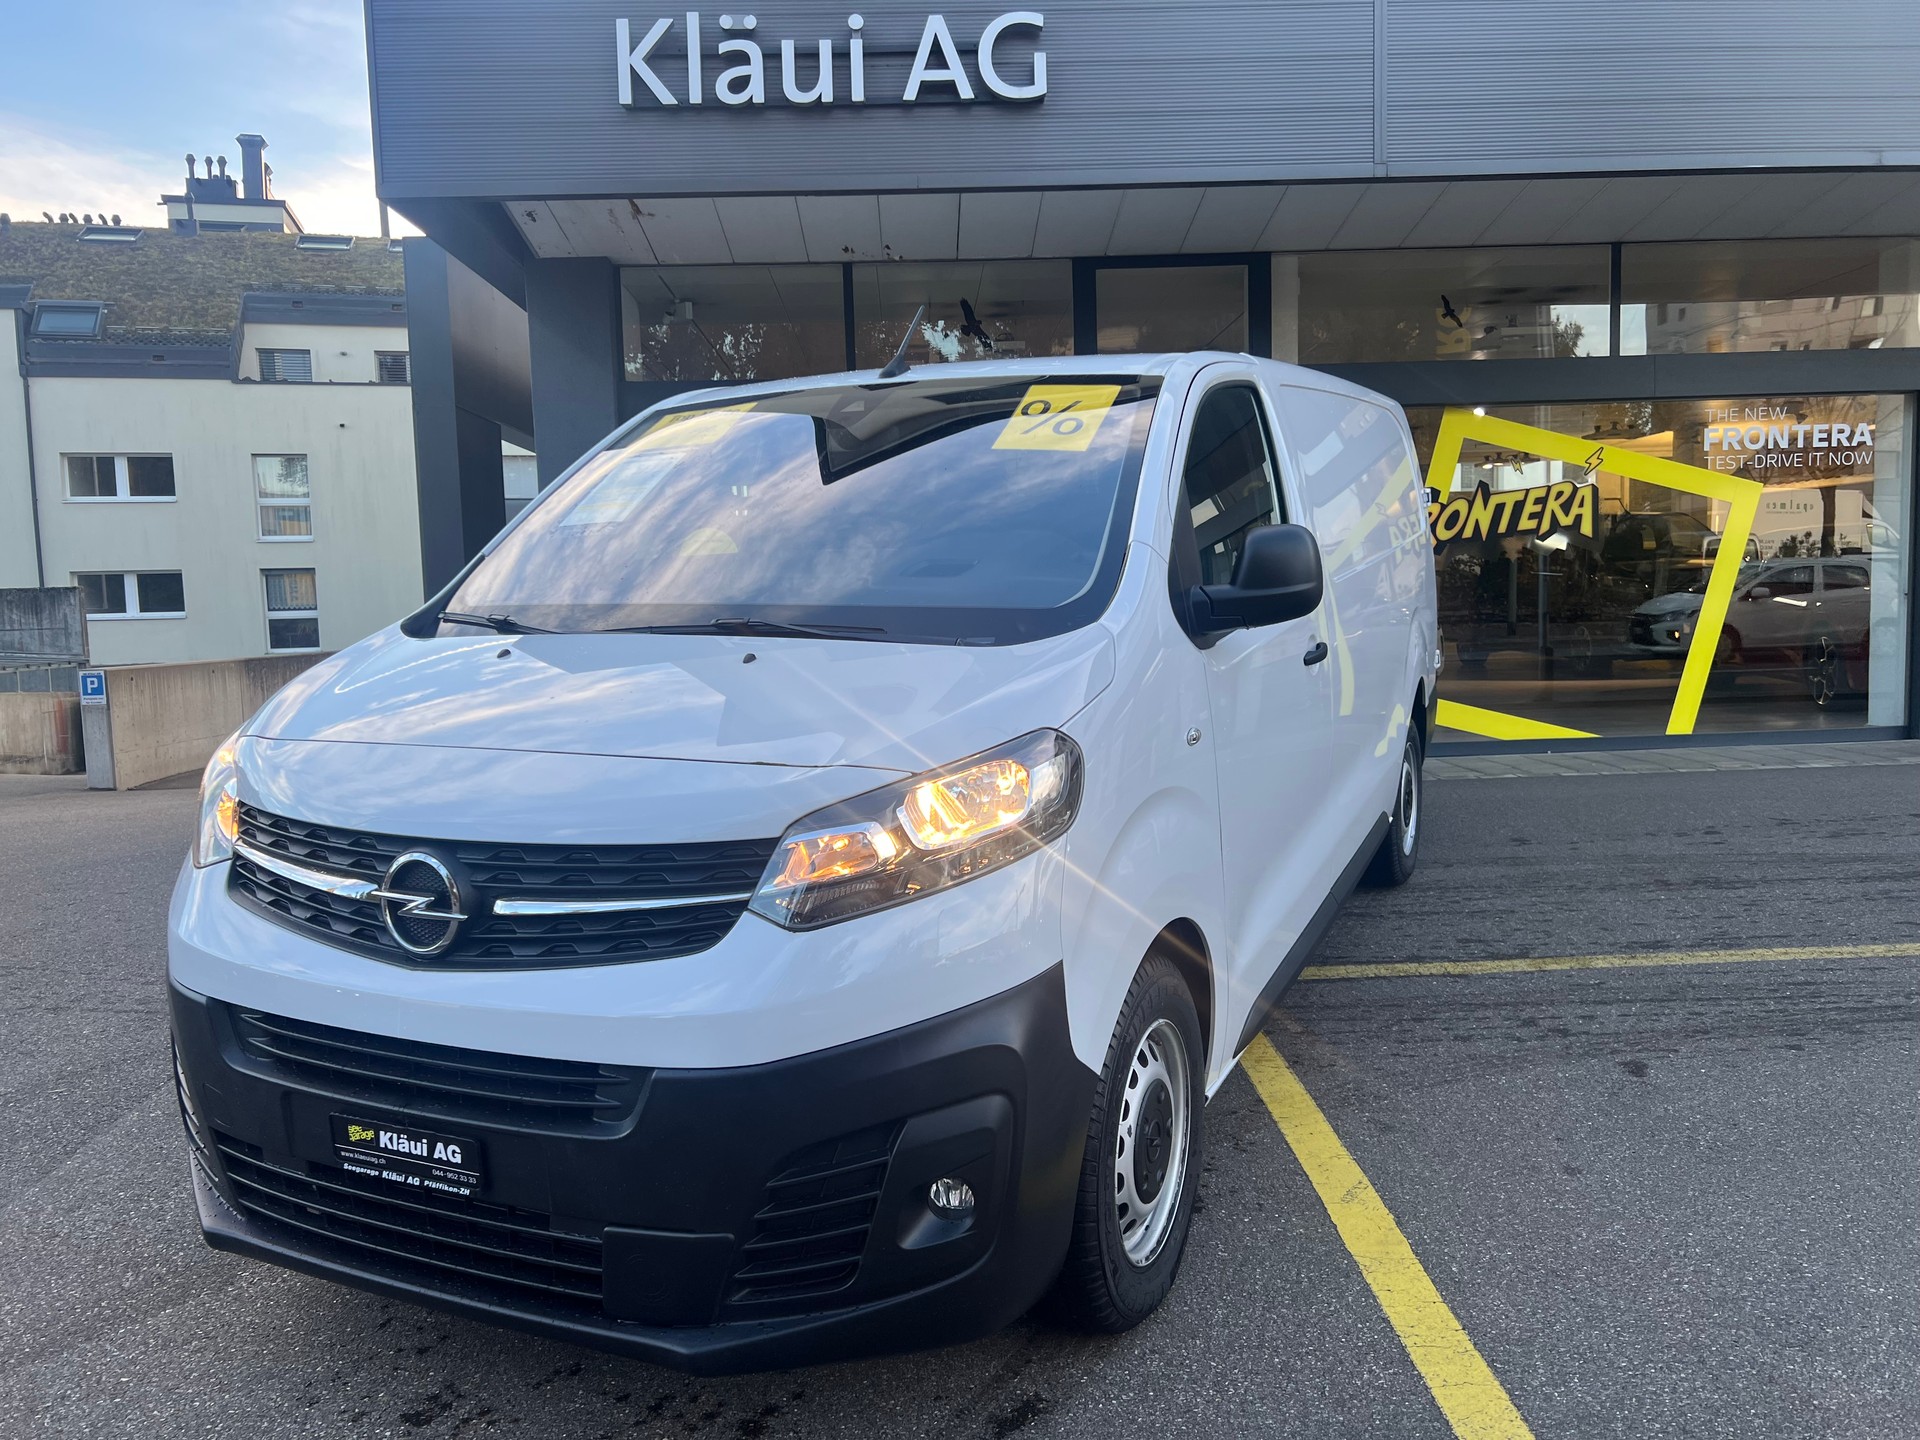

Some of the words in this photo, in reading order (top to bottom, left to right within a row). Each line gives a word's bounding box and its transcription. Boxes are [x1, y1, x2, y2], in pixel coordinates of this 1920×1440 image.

[616, 11, 864, 105] Kläui
[902, 11, 1048, 102] AG
[1704, 407, 1740, 423] THE
[1744, 406, 1788, 421] NEW
[1703, 422, 1873, 451] FRONTERA
[1703, 453, 1804, 471] TEST-DRIVE
[1808, 452, 1824, 467] IT
[1828, 450, 1874, 467] NOW
[1430, 480, 1599, 556] RONTERA
[86, 677, 99, 694] P
[379, 1130, 428, 1157] Kläui
[433, 1142, 462, 1164] AG
[382, 1170, 405, 1183] Kläui
[406, 1175, 421, 1186] AG
